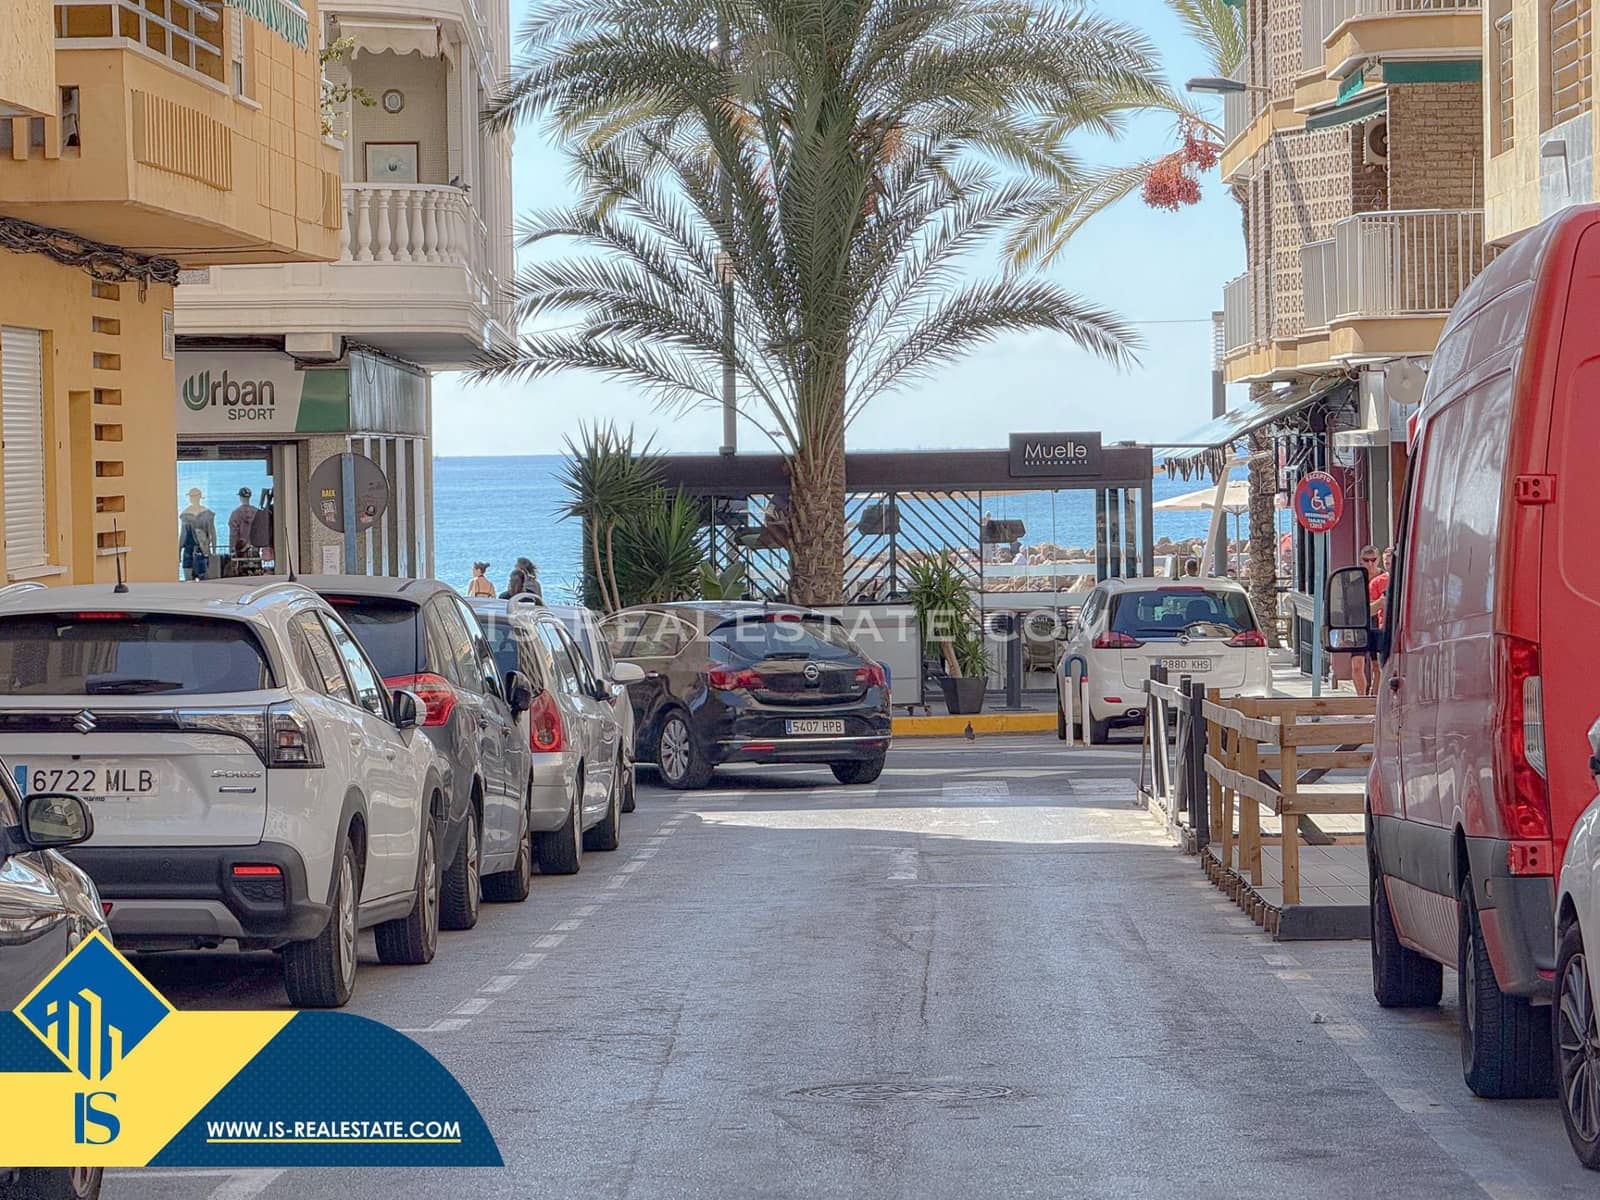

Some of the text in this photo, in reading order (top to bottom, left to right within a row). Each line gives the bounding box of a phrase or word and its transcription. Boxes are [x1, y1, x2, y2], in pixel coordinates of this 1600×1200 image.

[183, 370, 275, 411] Urban
[228, 408, 275, 420] SPORT
[1025, 441, 1087, 459] Muelle
[1162, 660, 1209, 669] 2880 KHS
[792, 721, 843, 732] 5407 HPB
[32, 769, 153, 792] 6722 MLB
